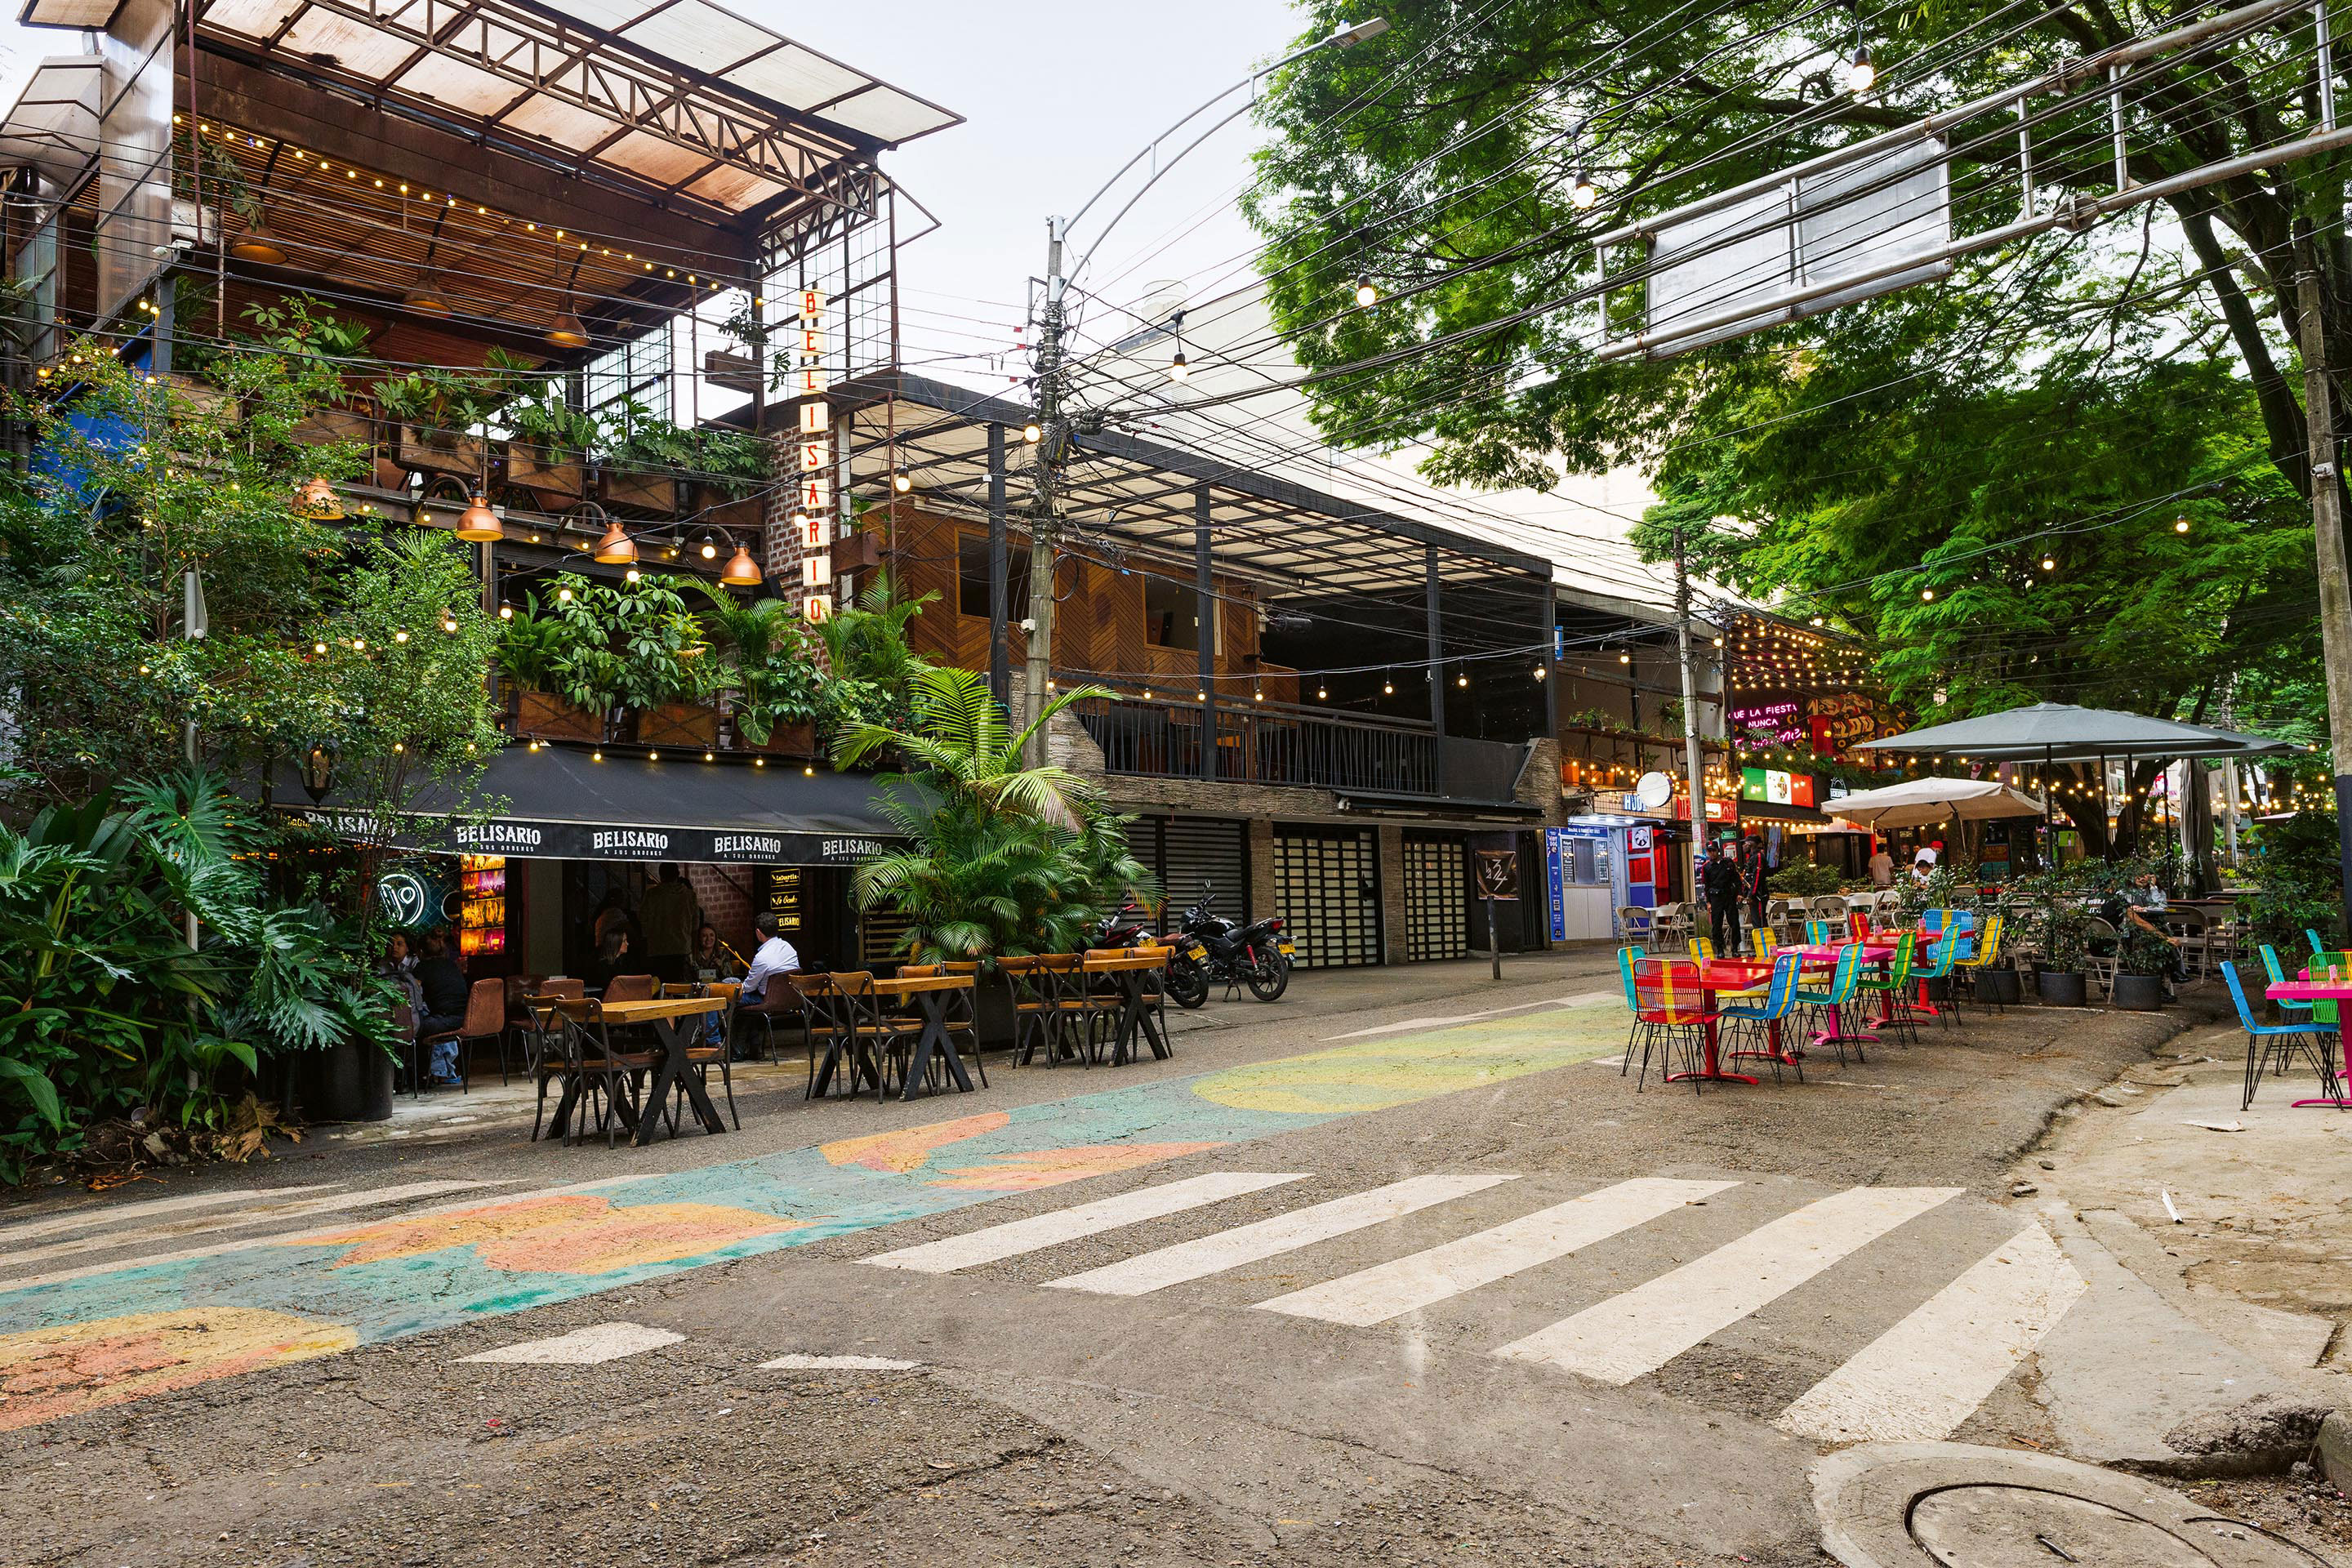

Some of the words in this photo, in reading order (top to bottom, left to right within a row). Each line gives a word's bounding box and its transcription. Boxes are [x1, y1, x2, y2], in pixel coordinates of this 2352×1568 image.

[805, 292, 821, 620] BELISARIO
[1749, 708, 1762, 717] LA
[1748, 718, 1779, 728] NUNCA
[456, 824, 542, 845] BELISARIO
[593, 831, 669, 849] BELISARIO
[714, 835, 782, 853] BELISARIO
[822, 839, 883, 856] BELISARIO
[777, 916, 800, 927] ELISARIO
